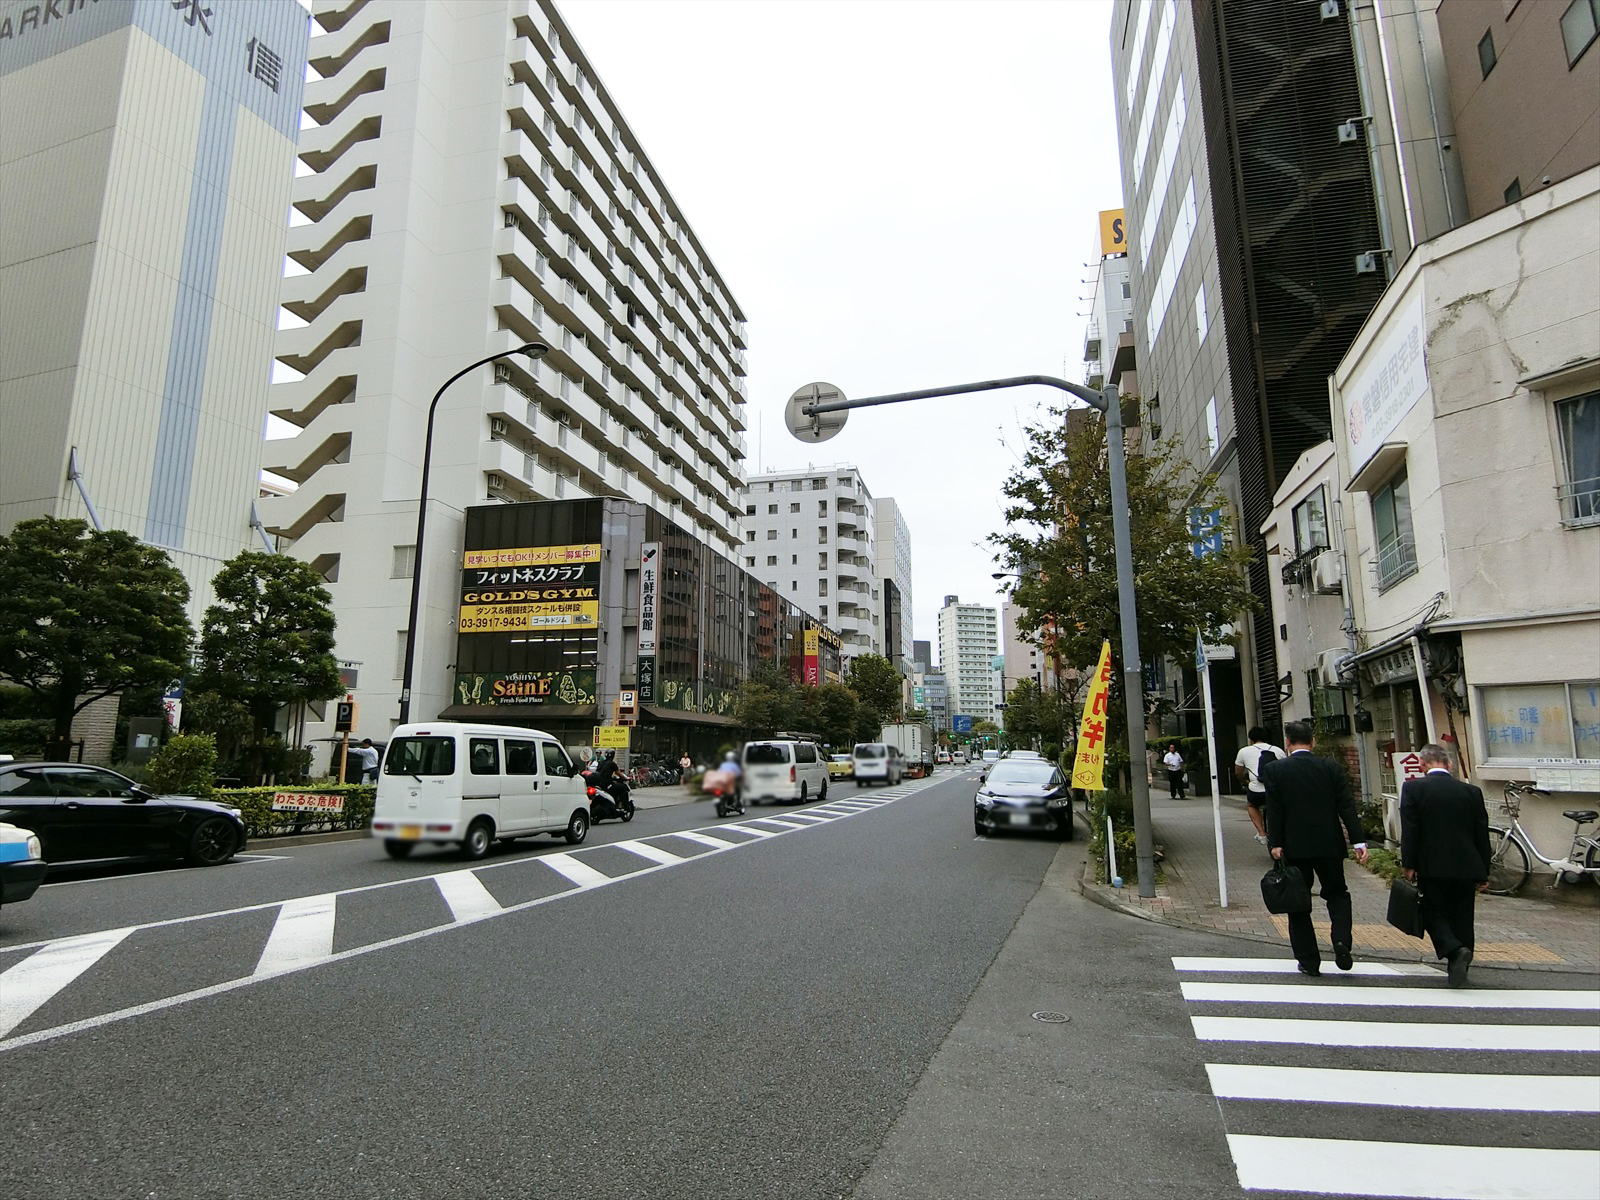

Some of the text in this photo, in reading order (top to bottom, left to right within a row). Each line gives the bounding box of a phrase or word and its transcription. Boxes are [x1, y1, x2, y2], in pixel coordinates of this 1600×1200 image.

[1112, 218, 1127, 244] S
[476, 565, 586, 584] フィットネスクラブ
[463, 589, 540, 603] GOLD'S
[642, 569, 655, 631] 生鮮食品館
[461, 616, 527, 629] 03-3917-9434
[640, 659, 652, 697] 大塚店
[500, 696, 515, 704] Fresh
[623, 693, 632, 701] P
[340, 705, 350, 721] P
[275, 793, 343, 808] わたるな危険!
